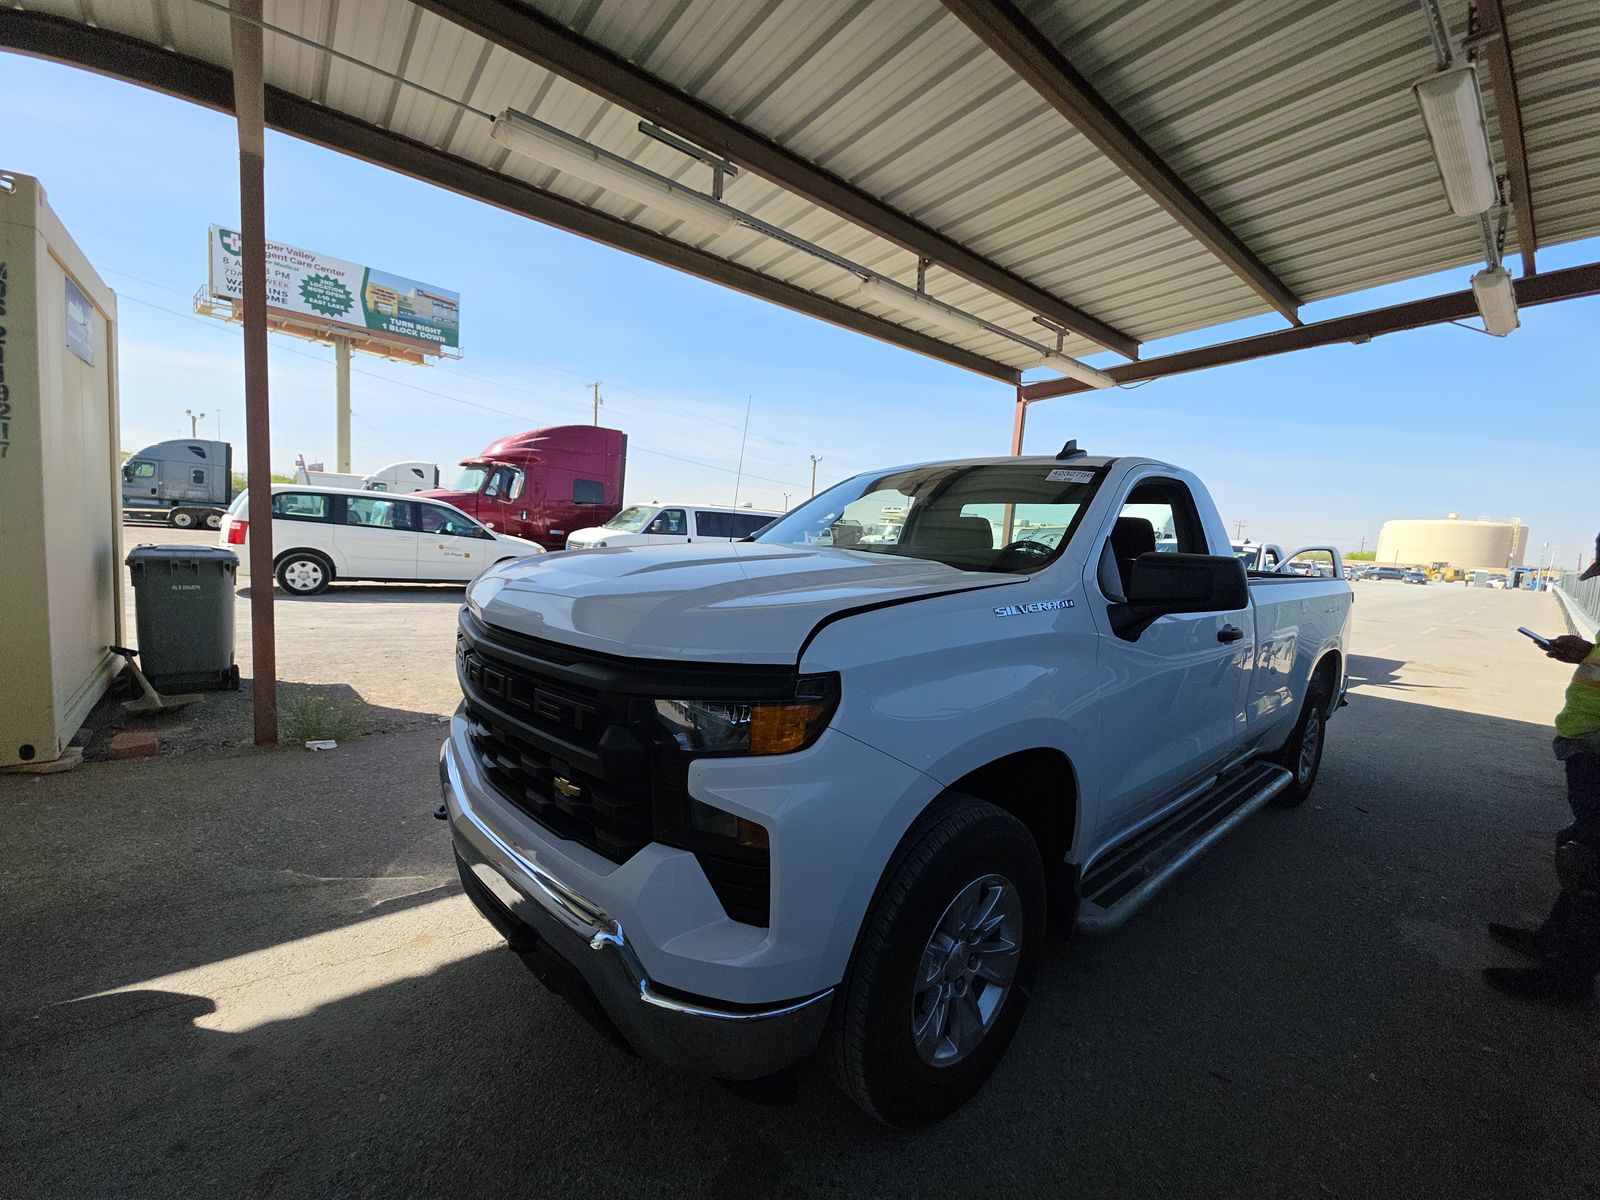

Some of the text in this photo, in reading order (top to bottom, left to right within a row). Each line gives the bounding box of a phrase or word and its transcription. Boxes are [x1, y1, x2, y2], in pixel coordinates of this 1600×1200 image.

[286, 247, 316, 262] Valley
[222, 256, 229, 265] 8
[275, 270, 291, 280] PM
[290, 258, 313, 269] Care
[313, 263, 346, 277] Center
[307, 286, 325, 294] NOW
[309, 281, 344, 294] LOCATION
[308, 297, 345, 311] EAST LAKE
[381, 322, 446, 343] 1 BLOCK DOWN
[389, 317, 442, 335] TURN RIGHT
[993, 599, 1075, 618] SILVERADO
